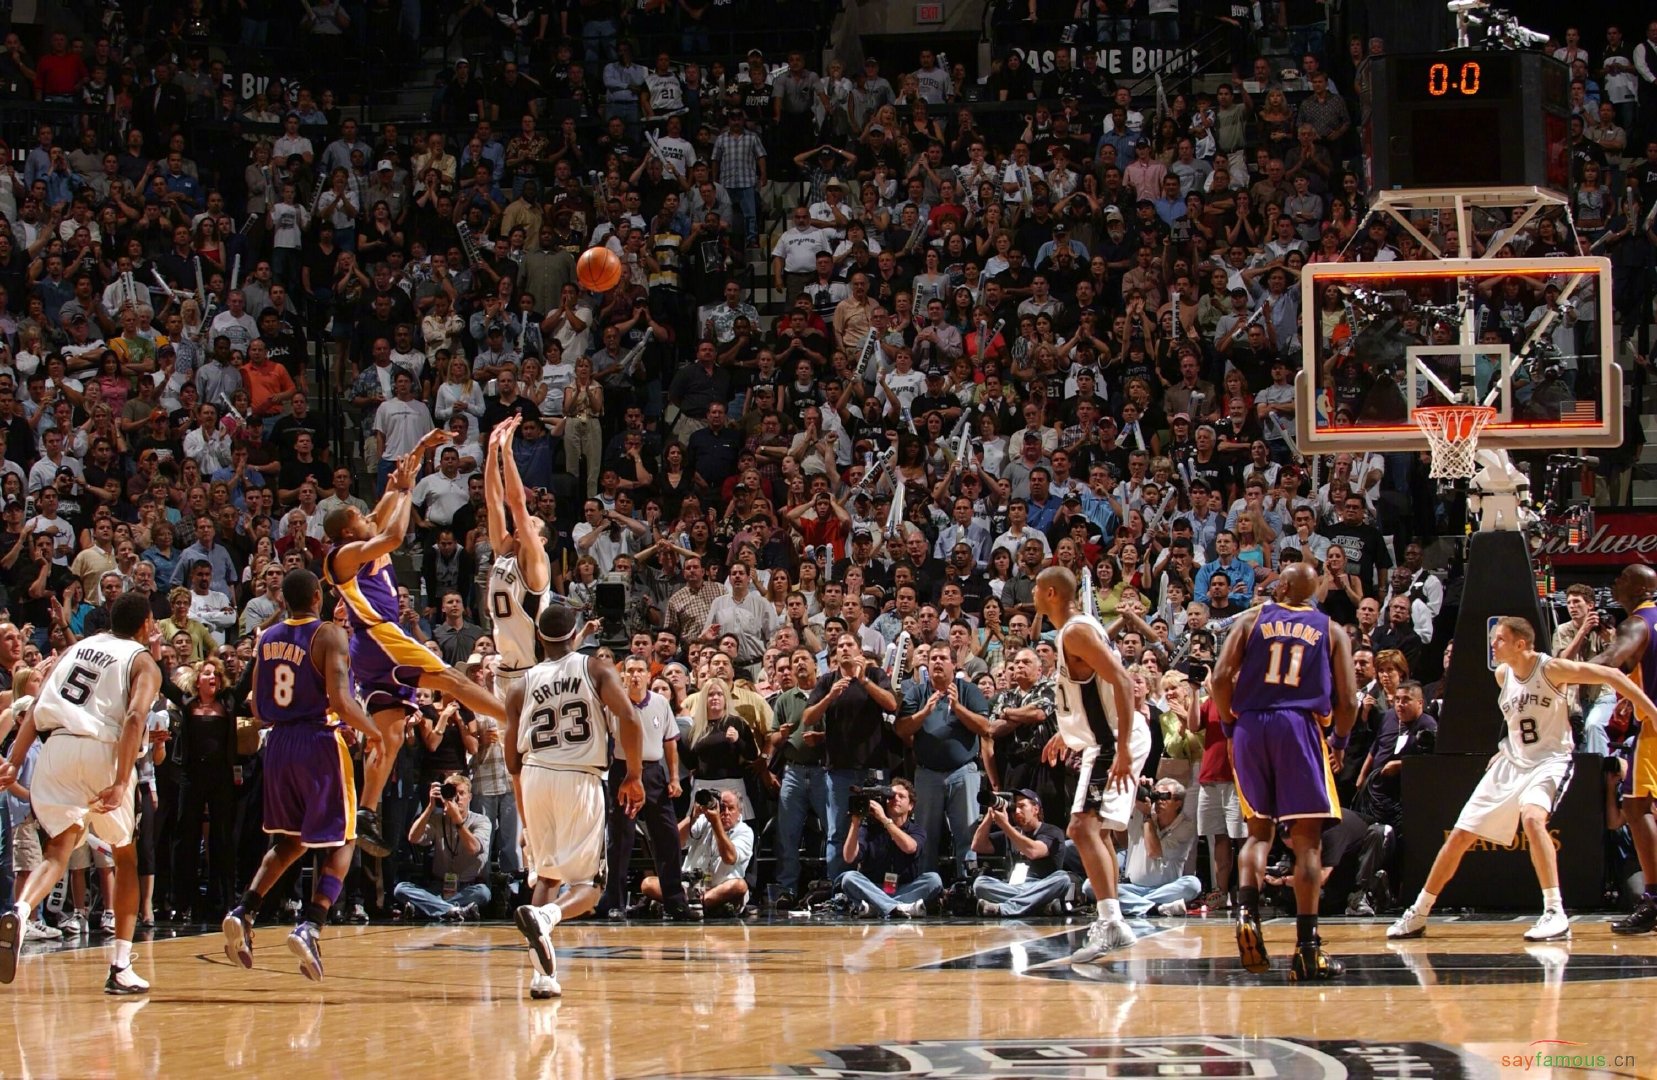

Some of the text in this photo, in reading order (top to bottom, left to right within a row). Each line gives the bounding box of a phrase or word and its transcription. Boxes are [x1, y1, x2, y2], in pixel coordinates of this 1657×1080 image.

[921, 7, 939, 20] EXIT
[918, 77, 939, 89] PURS
[1428, 62, 1481, 96] 0.0
[661, 89, 675, 100] 21
[891, 386, 915, 397] PURS
[1047, 386, 1061, 398] 21
[1260, 621, 1323, 646] MALONE
[76, 648, 119, 680] HORRY
[262, 641, 307, 667] BRYANT
[1264, 642, 1304, 688] 11
[60, 664, 101, 707] 5
[273, 663, 296, 708] 8
[532, 679, 582, 705] BROWN
[1502, 694, 1552, 715] SPURS
[531, 701, 592, 749] 23
[1519, 717, 1538, 745] 8
